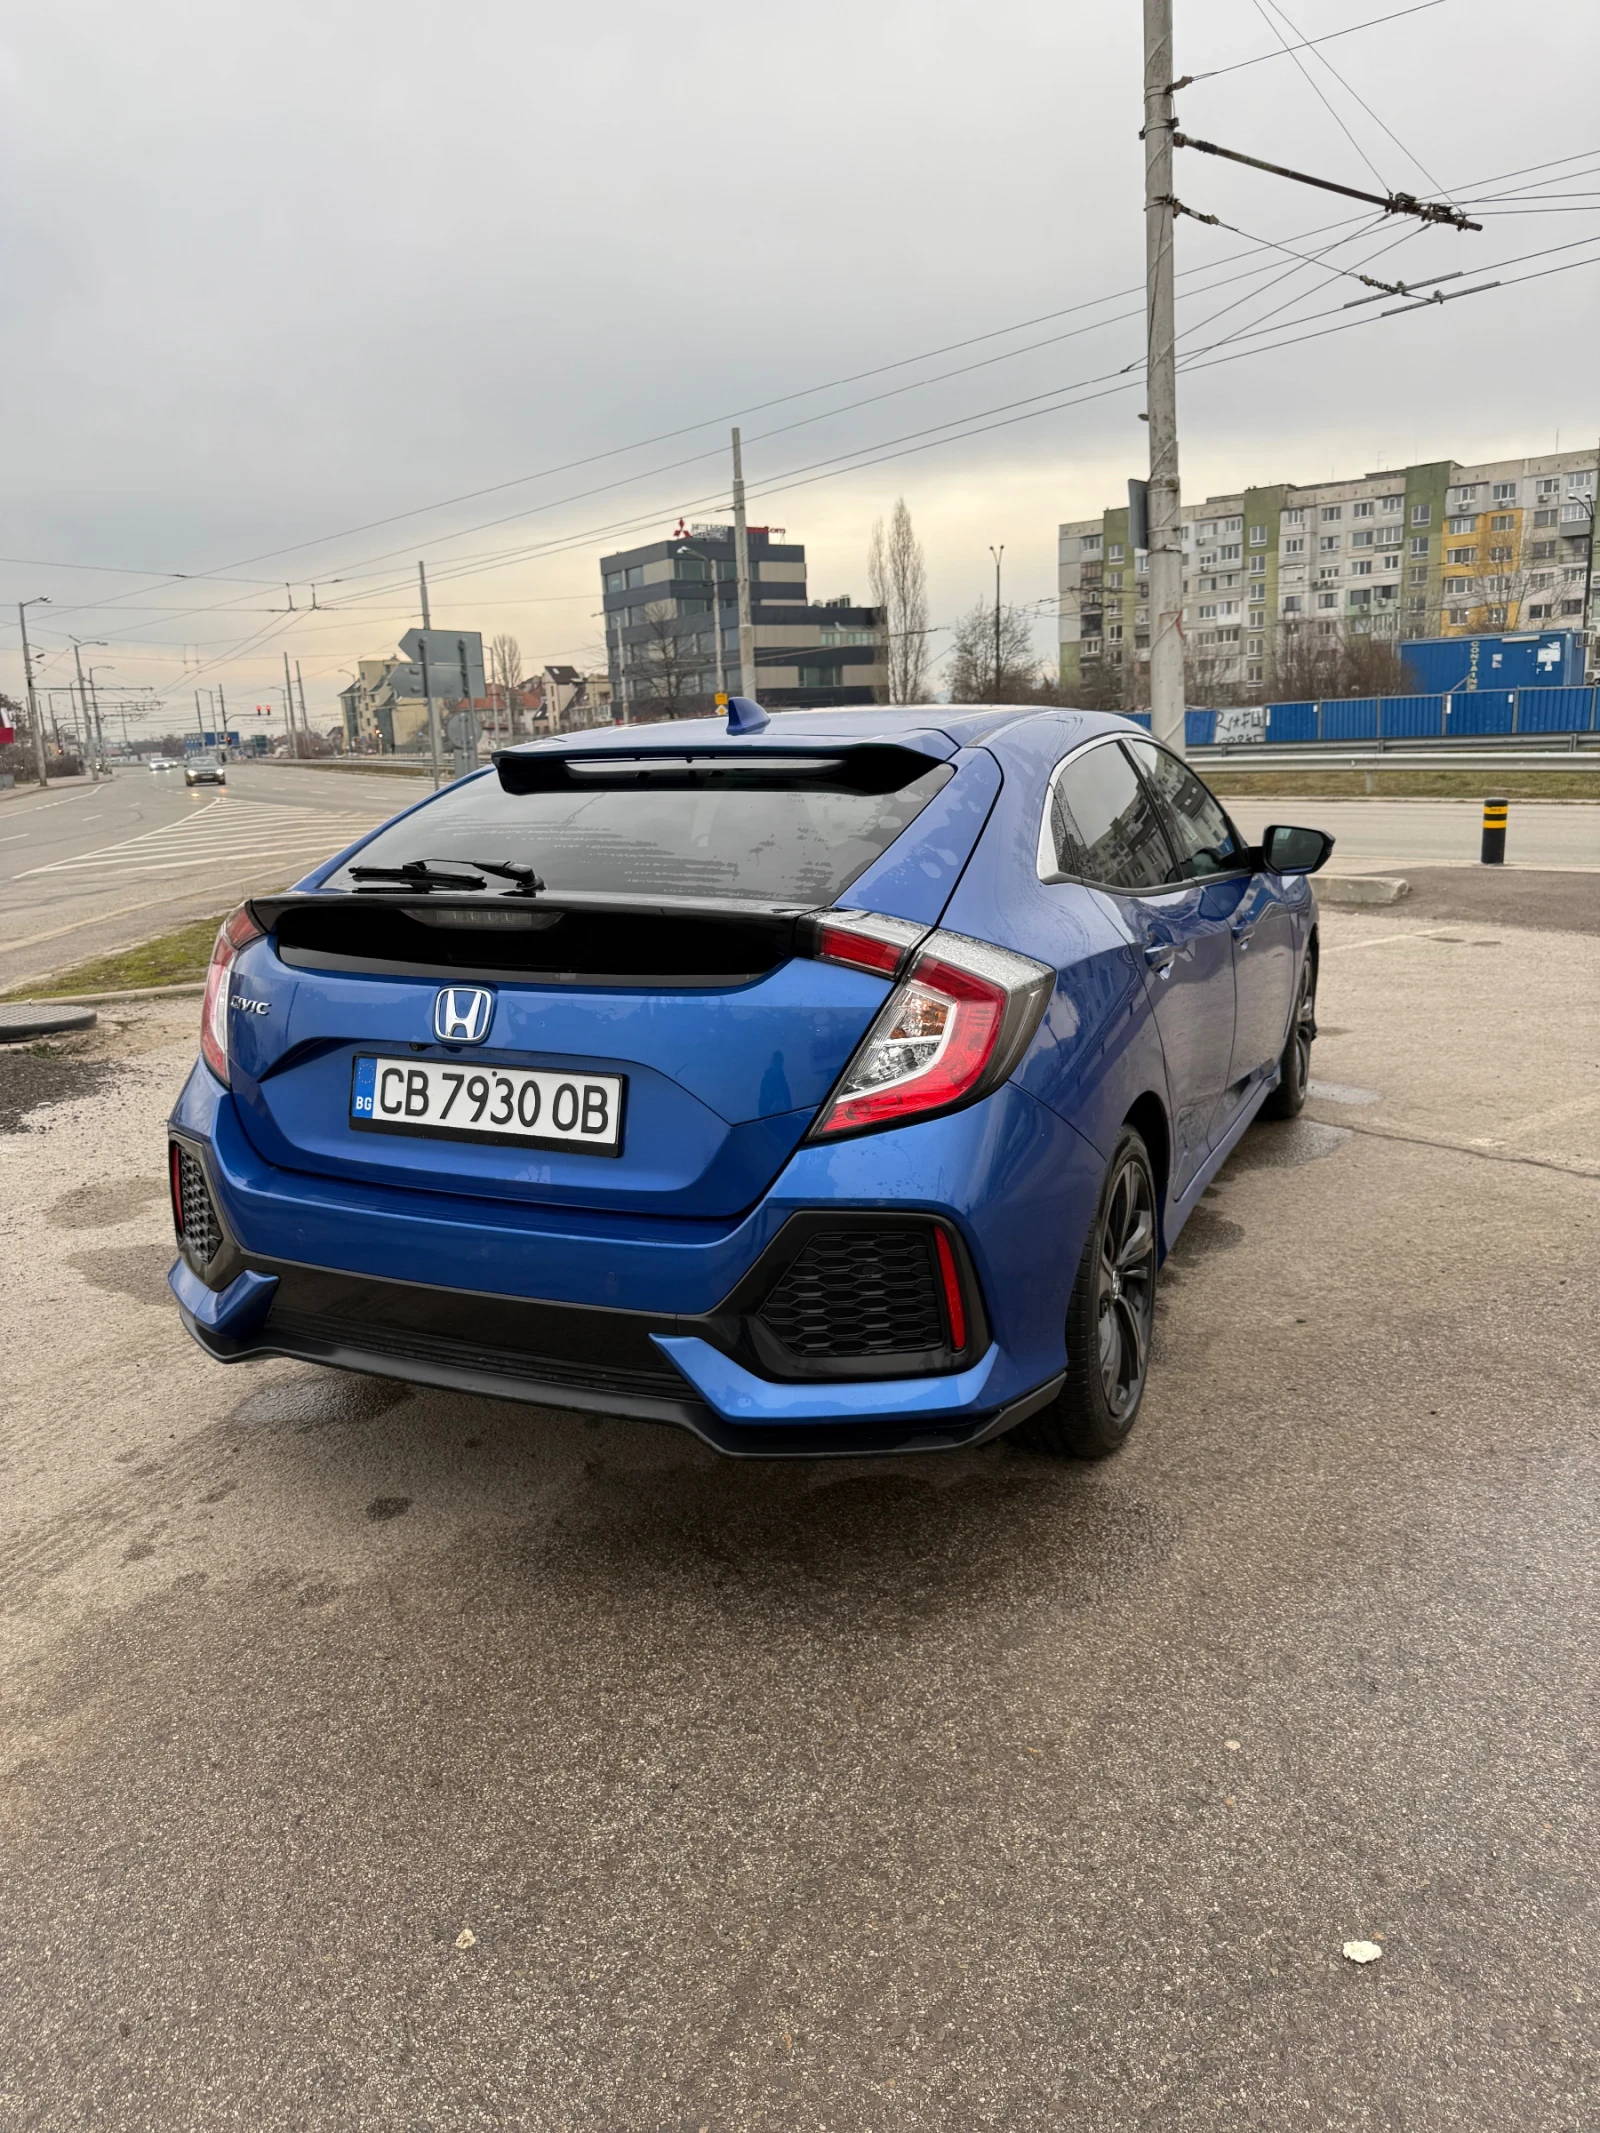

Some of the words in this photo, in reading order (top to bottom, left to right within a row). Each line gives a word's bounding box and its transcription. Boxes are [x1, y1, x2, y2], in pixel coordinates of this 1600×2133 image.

[230, 995, 272, 1016] CIVIC
[355, 1096, 372, 1111] BG
[380, 1067, 429, 1117] CB
[439, 1072, 541, 1128] 7930
[552, 1083, 609, 1135] OB
